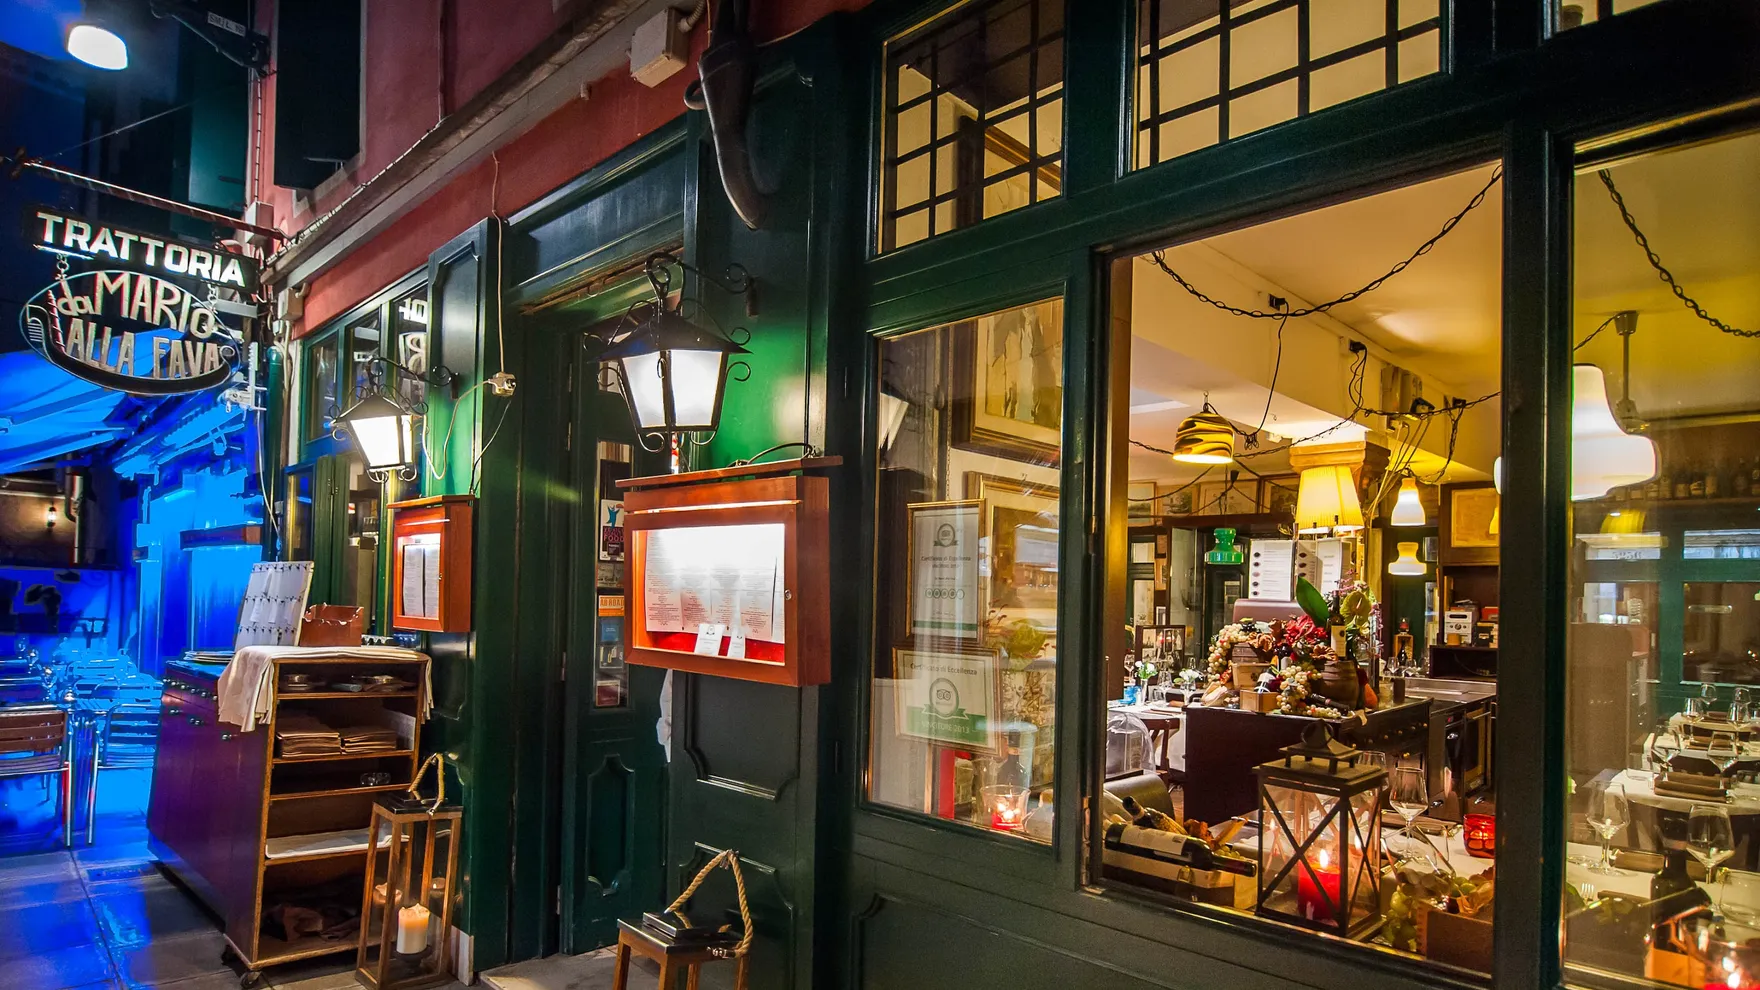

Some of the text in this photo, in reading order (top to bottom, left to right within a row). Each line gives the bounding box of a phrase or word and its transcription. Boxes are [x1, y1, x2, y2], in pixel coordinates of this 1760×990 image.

[37, 212, 246, 287] TRATTORIA
[56, 271, 215, 338] da MARIO
[65, 318, 219, 380] ALLA FAVA
[947, 664, 978, 676] Eccellenza
[953, 723, 970, 734] 2013
